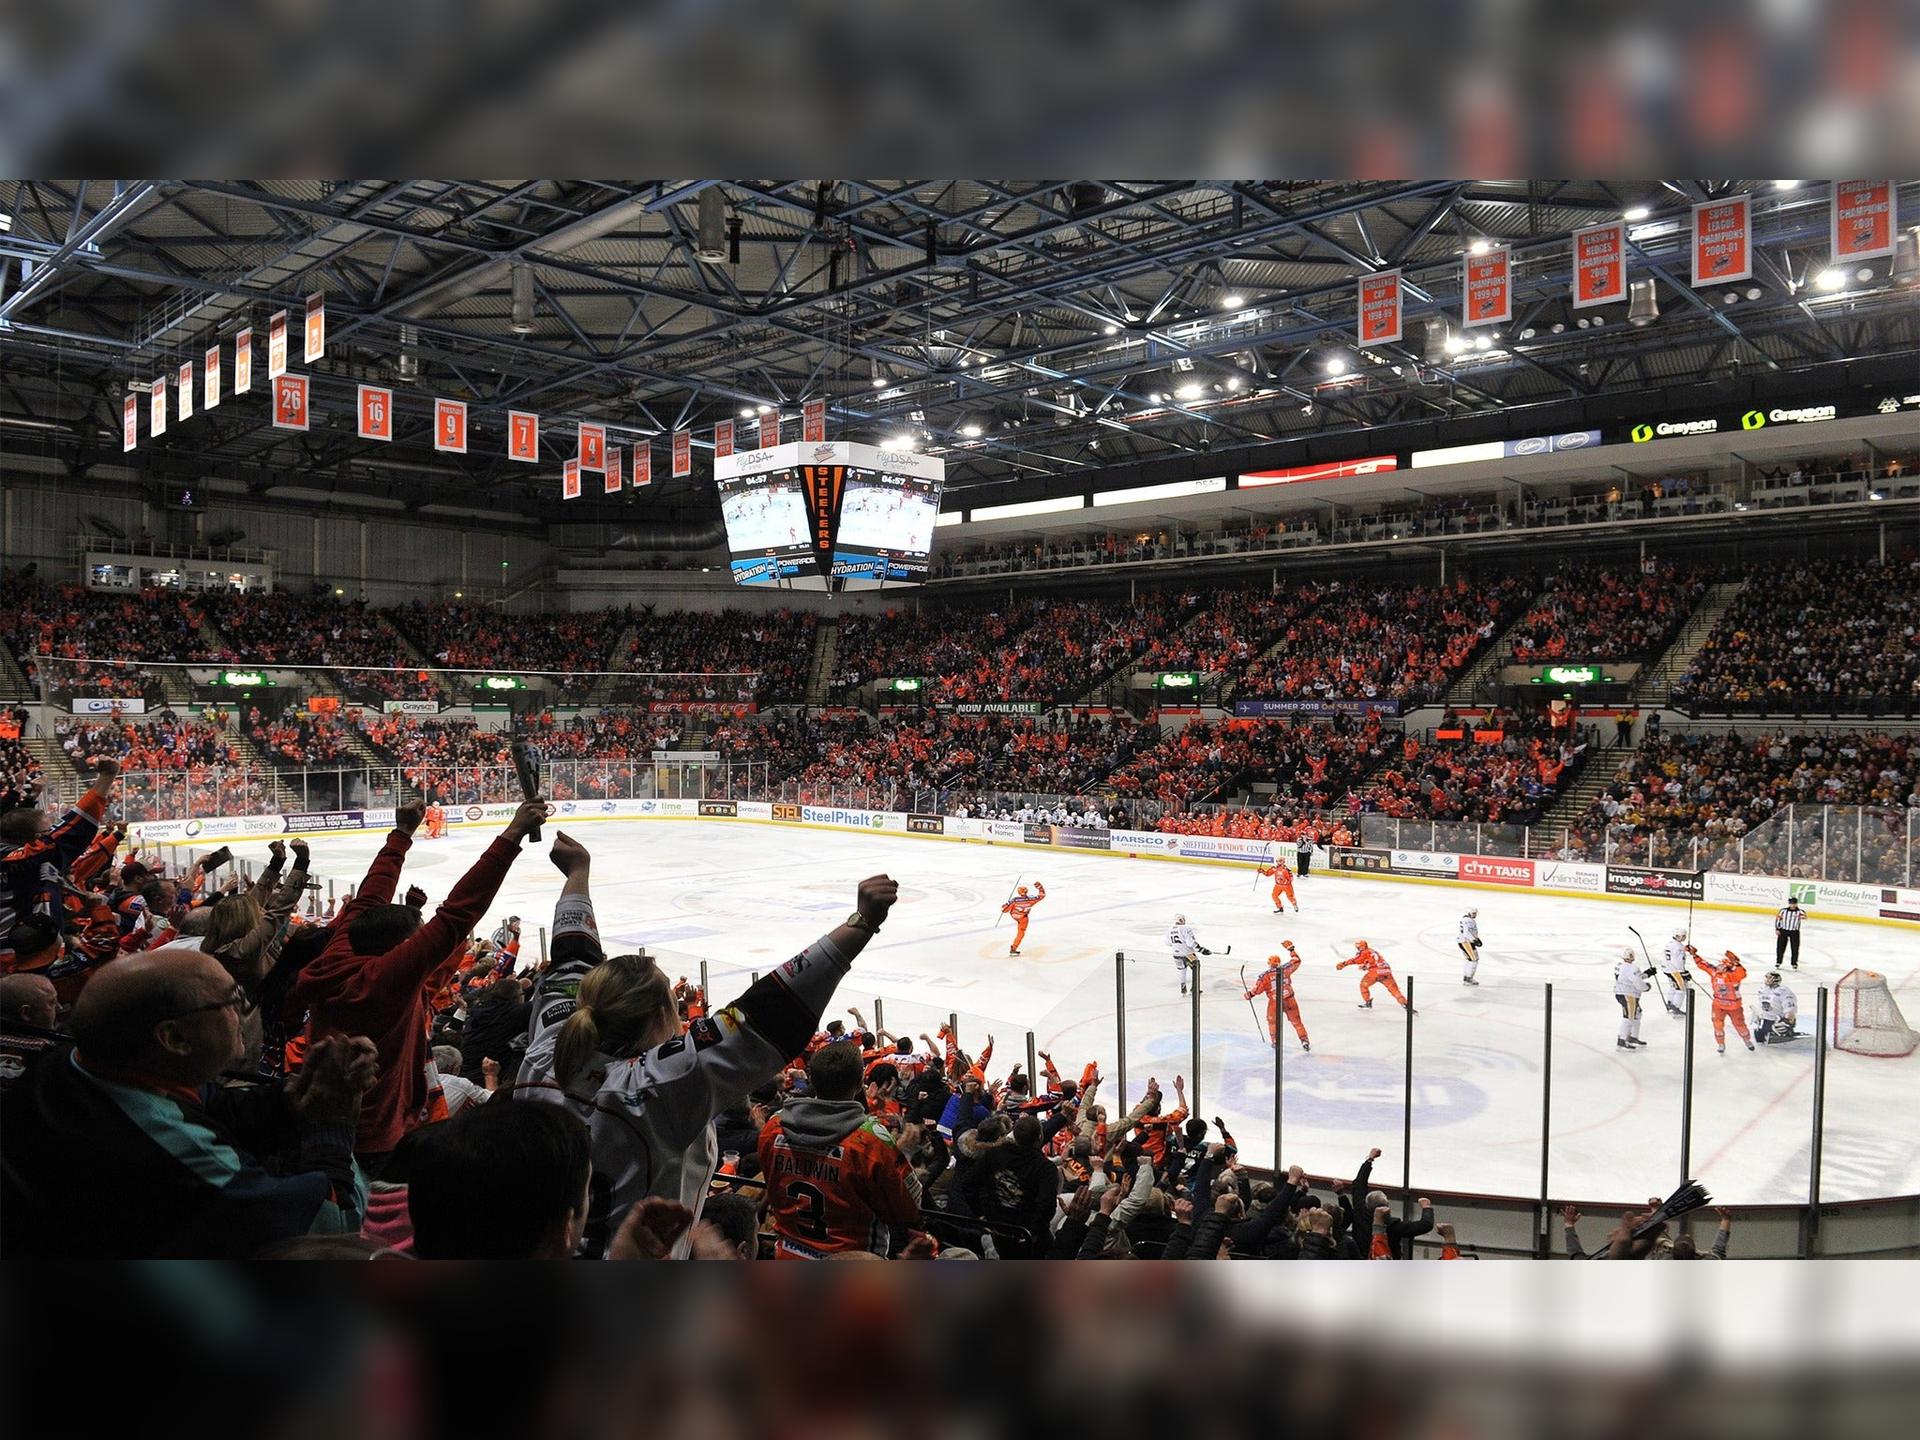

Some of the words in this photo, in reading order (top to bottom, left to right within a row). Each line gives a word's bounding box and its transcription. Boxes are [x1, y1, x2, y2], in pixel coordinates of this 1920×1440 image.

[1700, 228, 1744, 245] CHAMPIONS
[282, 389, 302, 410] 26
[368, 402, 384, 422] 16
[446, 415, 456, 434] 9
[520, 428, 528, 444] 7
[588, 438, 596, 454] 4
[882, 475, 906, 486] 04:57
[818, 466, 830, 550] STEELERS
[734, 564, 767, 583] HYDRATION
[831, 562, 874, 575] HYDRATION
[958, 704, 982, 712] NOW
[984, 704, 1036, 713] AVAILABLE
[661, 802, 682, 810] lime
[774, 806, 800, 818] STEL
[803, 809, 870, 826] SteelPhalt
[144, 824, 182, 832] Keepmoat
[244, 822, 278, 830] UNISON
[994, 822, 1024, 832] Keepmoat
[994, 830, 1014, 838] Homes
[1112, 835, 1164, 845] HARSCO
[1182, 840, 1216, 850] SHEFFIELD
[1218, 842, 1244, 851] WINDOW
[1494, 864, 1530, 878] TAXIS
[1819, 886, 1860, 900] Holiday
[1861, 890, 1878, 900] Inn
[775, 1154, 840, 1181] BALDWIN
[786, 1180, 827, 1241] 3
